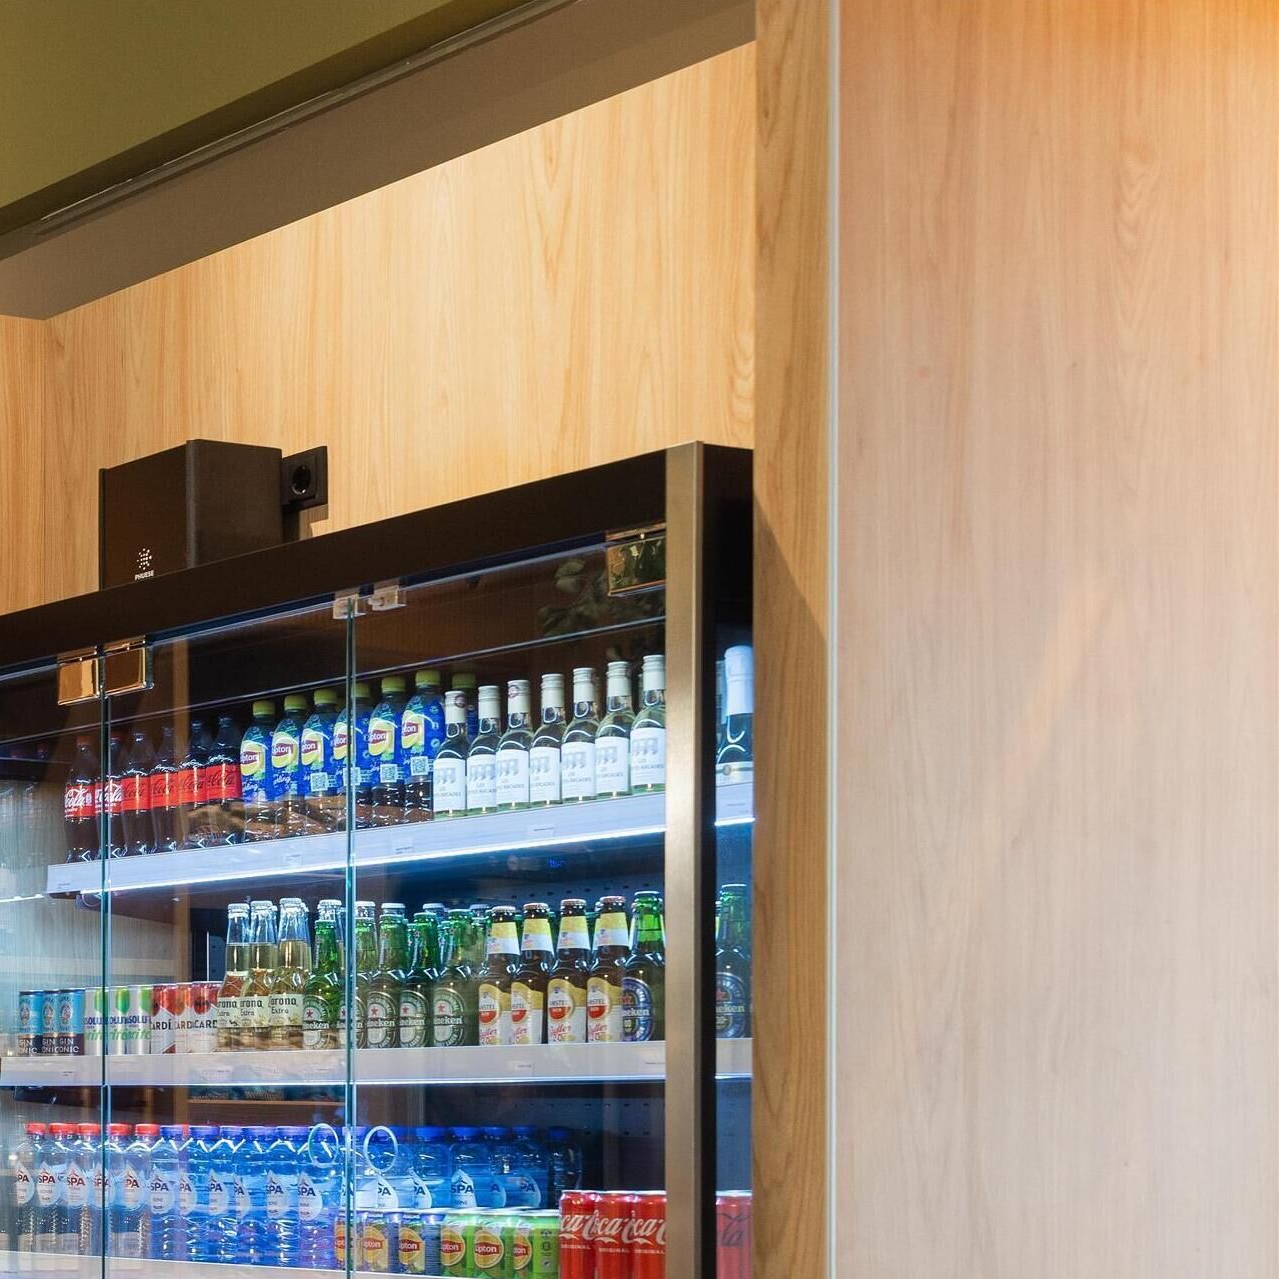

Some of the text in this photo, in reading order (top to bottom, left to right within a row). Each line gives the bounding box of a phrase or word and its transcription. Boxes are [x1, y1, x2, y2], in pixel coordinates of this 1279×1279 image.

[59, 1038, 74, 1046] GIN
[39, 1176, 55, 1184] SPA
[67, 1176, 85, 1185] SPA
[126, 1179, 139, 1188] PA
[150, 1182, 169, 1191] SPA
[179, 1183, 191, 1192] PA
[210, 1183, 223, 1192] PA
[234, 1186, 244, 1195] PA
[298, 1186, 315, 1196] SPA
[414, 1186, 426, 1195] PA
[451, 1184, 473, 1194] SPA
[377, 1187, 391, 1196] PA
